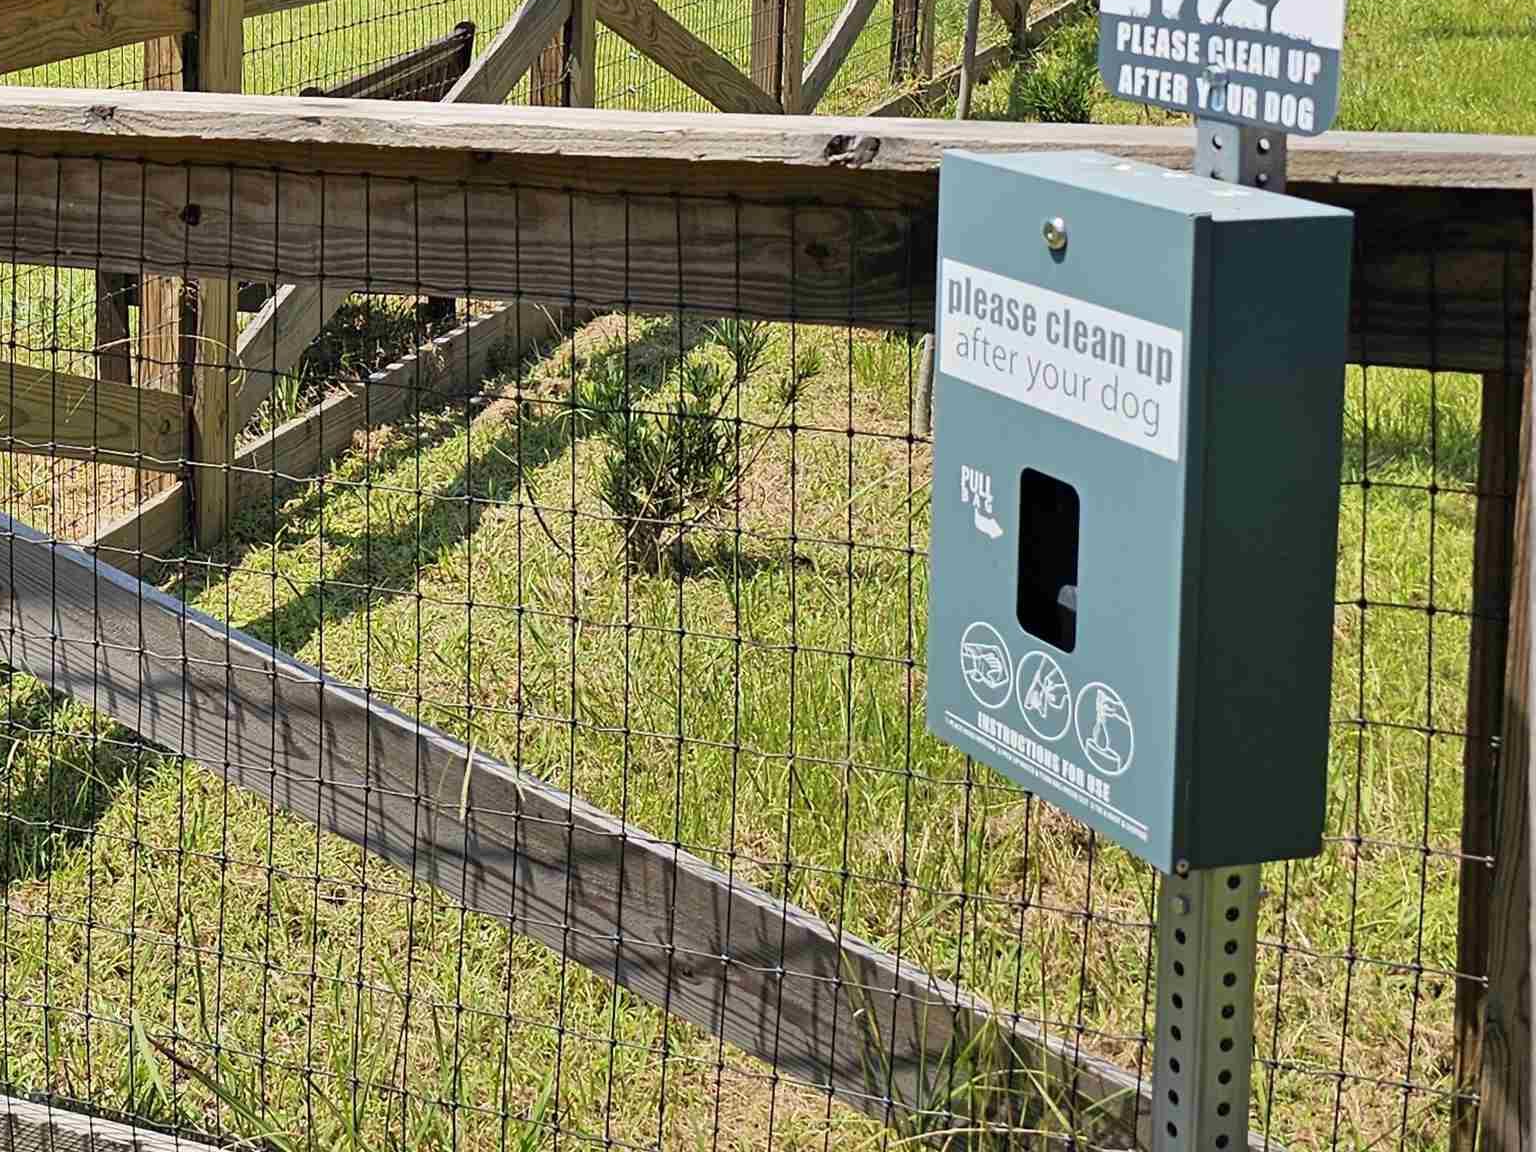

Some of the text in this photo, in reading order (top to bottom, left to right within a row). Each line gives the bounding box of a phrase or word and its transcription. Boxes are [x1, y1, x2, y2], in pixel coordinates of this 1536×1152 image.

[1116, 21, 1322, 86] PLEASE CLEAN UP
[1117, 64, 1315, 132] AFTER YOUR DOG
[948, 276, 1173, 386] please clean up
[955, 326, 1161, 438] after your dog
[960, 464, 992, 497] PULL
[977, 711, 1111, 803] INSTRUCTIONS FOR USE
